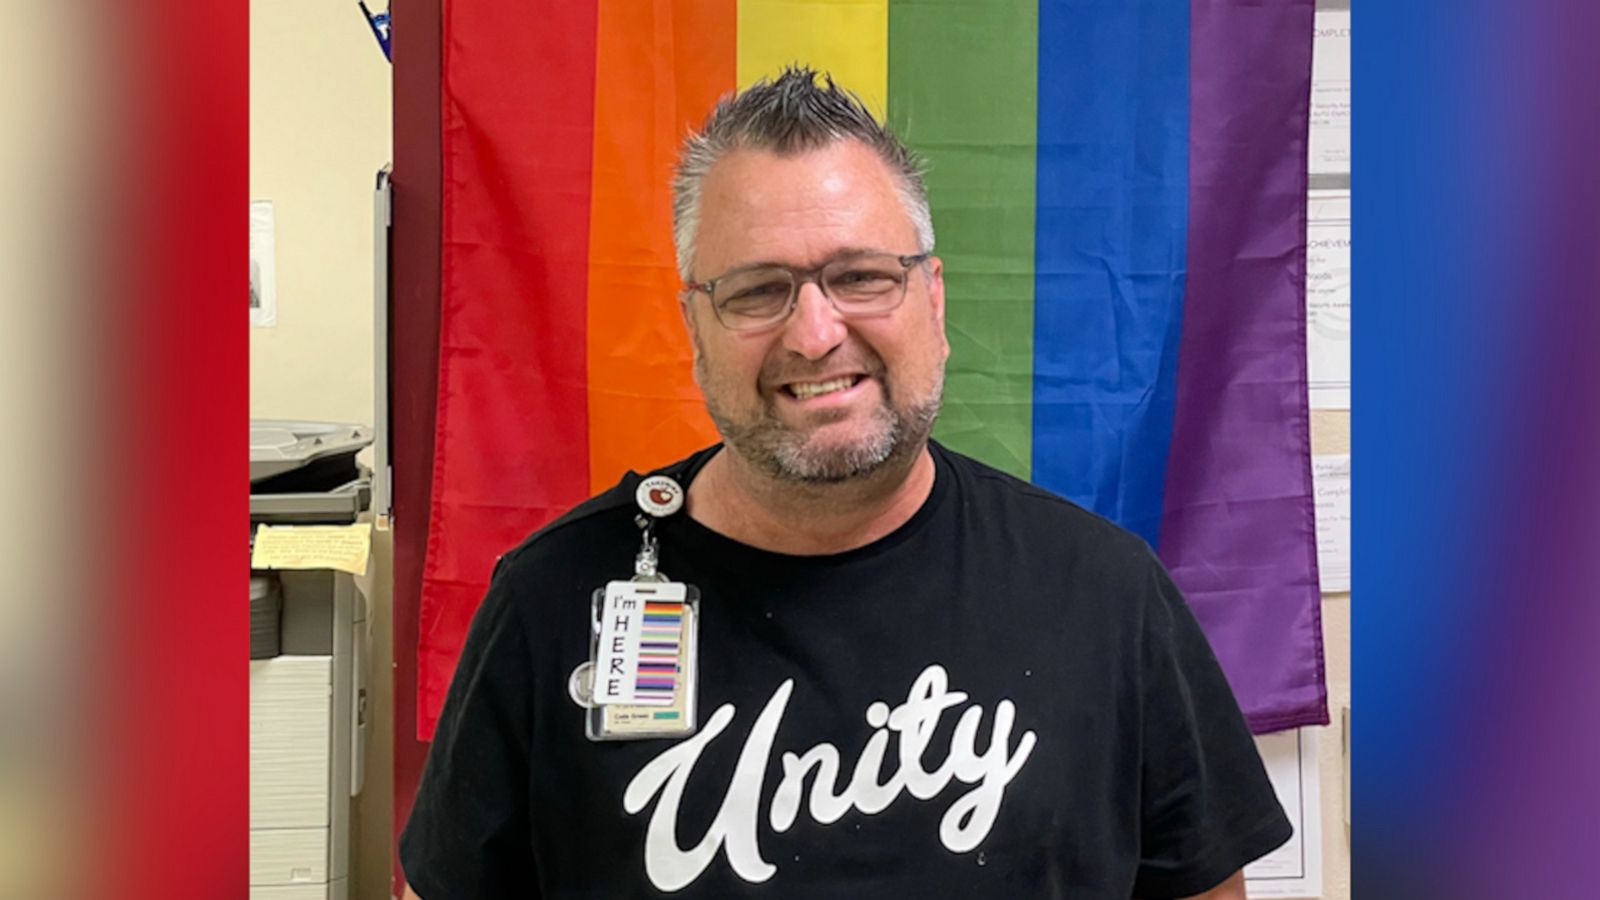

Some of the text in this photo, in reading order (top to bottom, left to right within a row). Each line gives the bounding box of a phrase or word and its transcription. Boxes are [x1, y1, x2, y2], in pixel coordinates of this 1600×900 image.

[614, 596, 637, 609] I'm
[607, 615, 629, 696] HERE
[623, 664, 1037, 892] Unity
